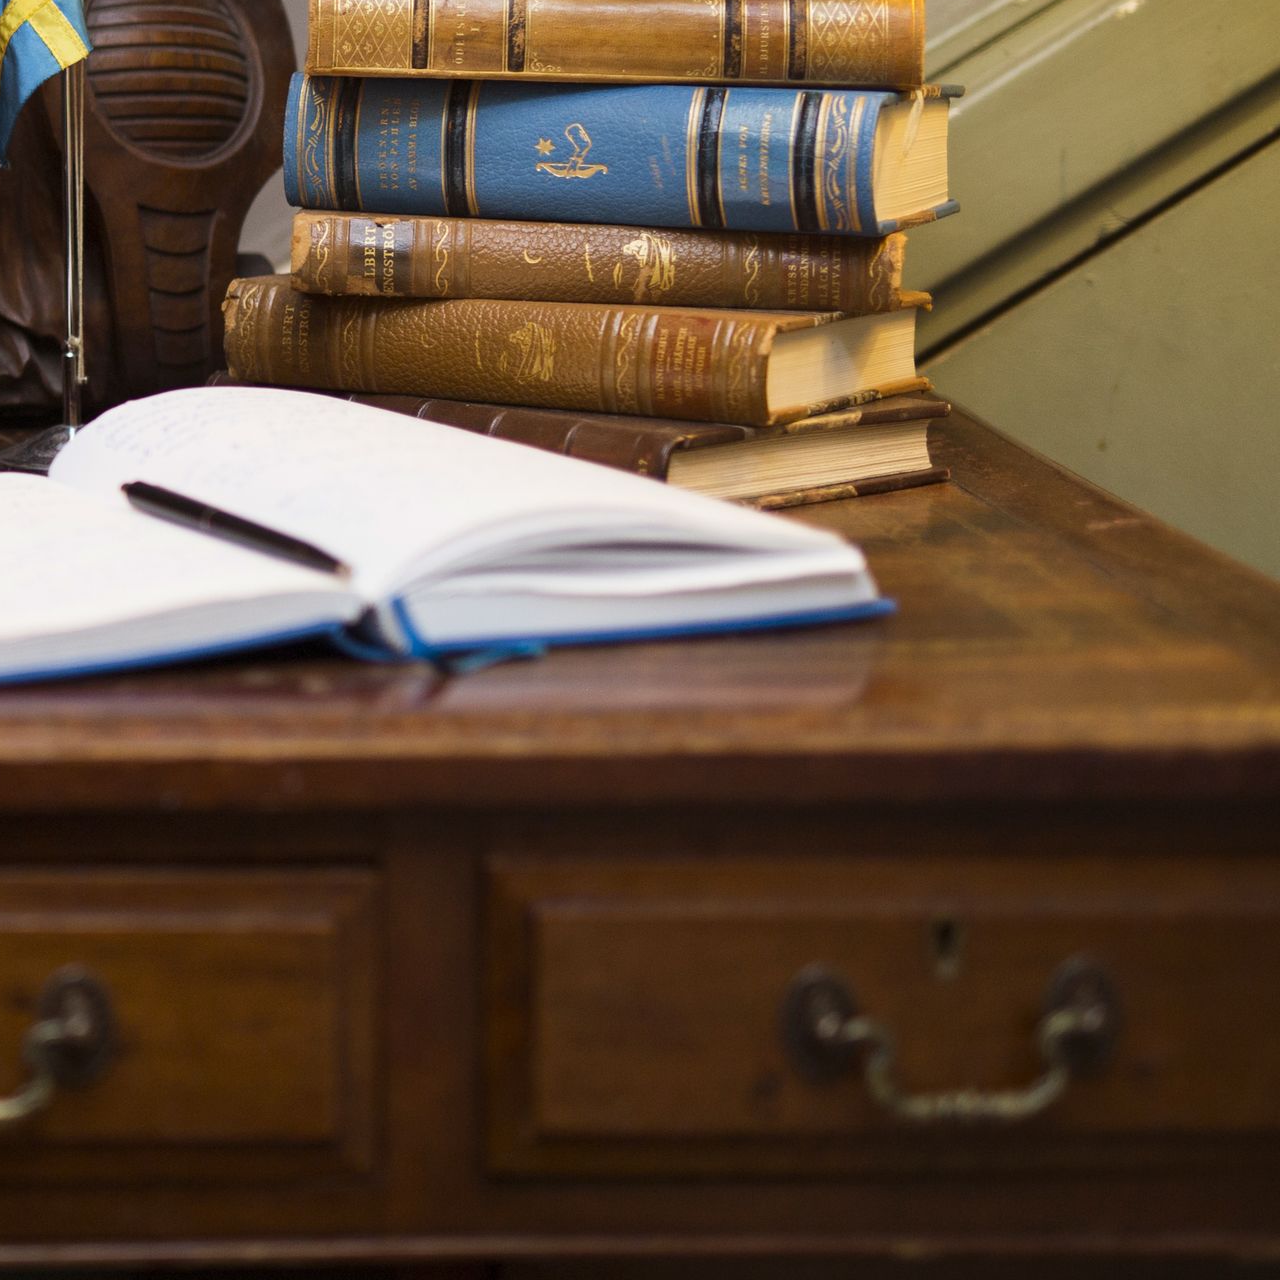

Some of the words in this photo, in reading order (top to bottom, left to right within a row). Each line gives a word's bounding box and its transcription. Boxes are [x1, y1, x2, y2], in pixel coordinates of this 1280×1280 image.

[408, 133, 417, 173] SAMMA
[738, 125, 748, 148] VON
[390, 162, 399, 190] VON
[408, 177, 417, 191] AV
[364, 225, 376, 277] LBERT
[382, 223, 395, 293] ENGSTRÖM
[787, 264, 797, 304] KRYSS
[281, 304, 295, 363] ALBERT
[298, 299, 312, 373] ENGSTRÖM
